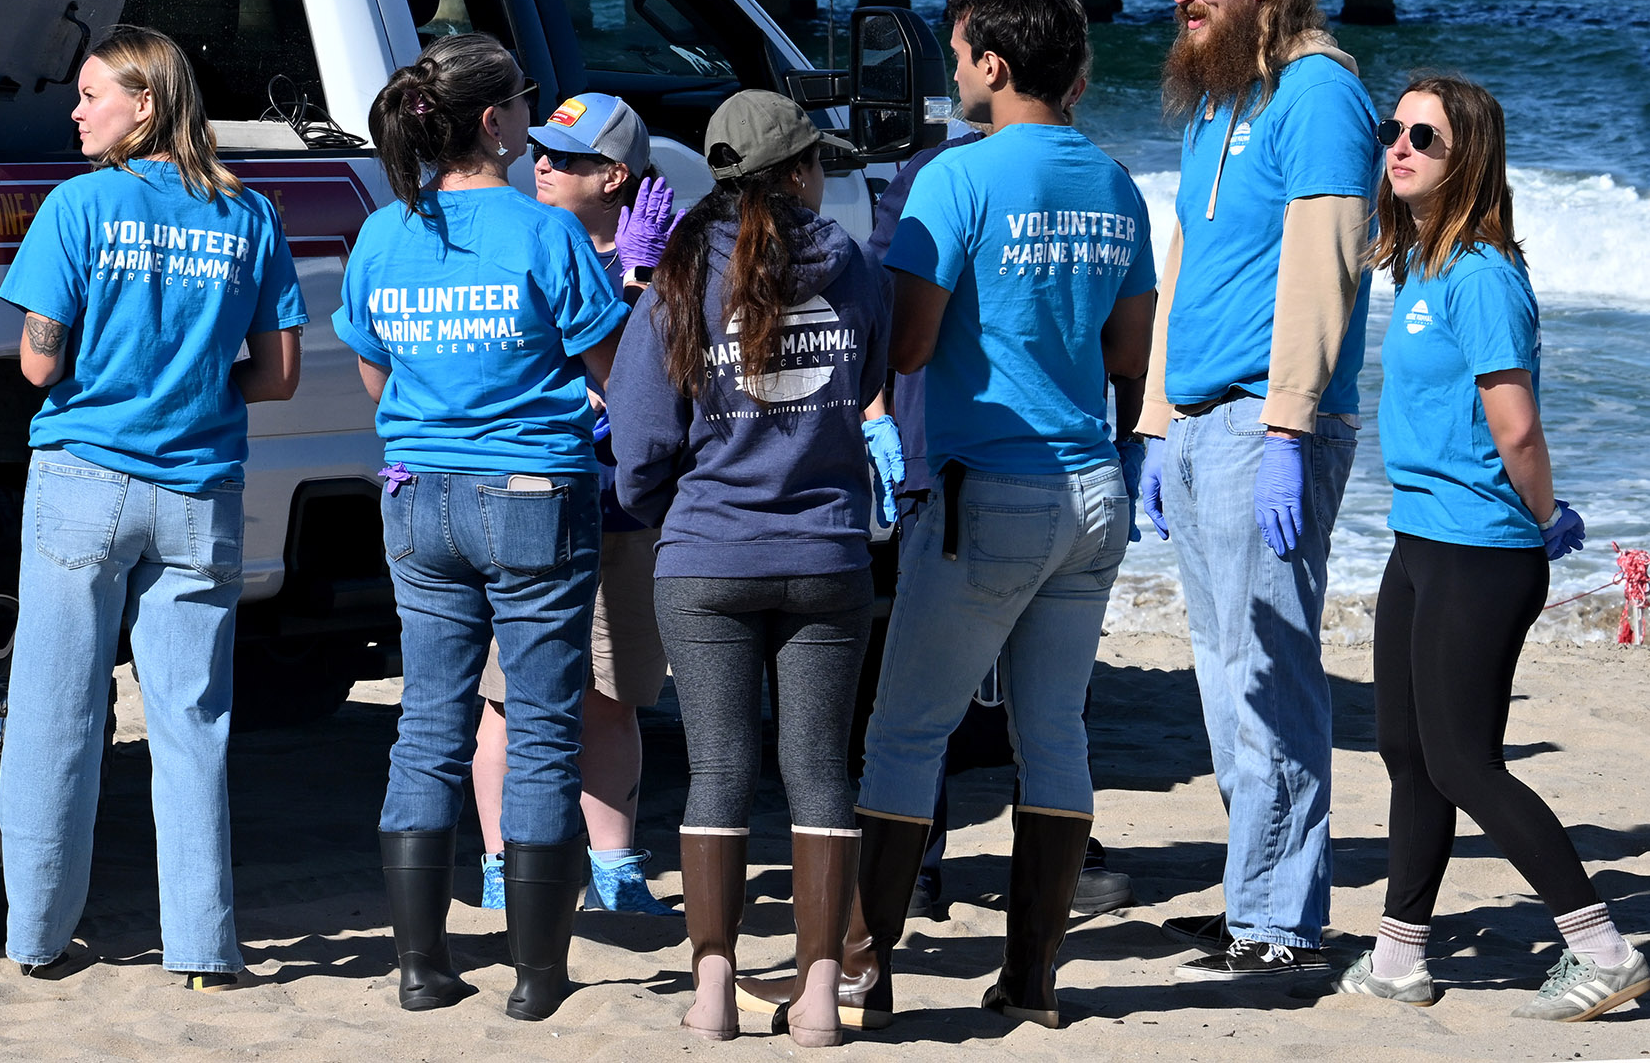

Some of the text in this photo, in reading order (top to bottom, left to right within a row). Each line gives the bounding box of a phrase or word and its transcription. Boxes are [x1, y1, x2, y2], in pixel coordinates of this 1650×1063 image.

[1006, 210, 1136, 242] VOLUNTEER
[103, 220, 250, 262] VOLUNTEER
[1001, 236, 1131, 267] MARINE MAMMAL
[98, 244, 241, 285] MARINE MAMMAL
[999, 265, 1128, 278] CARE CENTER
[96, 271, 240, 296] CARE CENTER
[368, 284, 520, 314] VOLUNTEER
[371, 313, 523, 342] MARINE MAMMAL
[436, 339, 525, 354] CENTER
[781, 328, 858, 356] MAMMAL
[706, 352, 858, 379] CAR CENTER
[768, 404, 818, 416] CALIFORNIA
